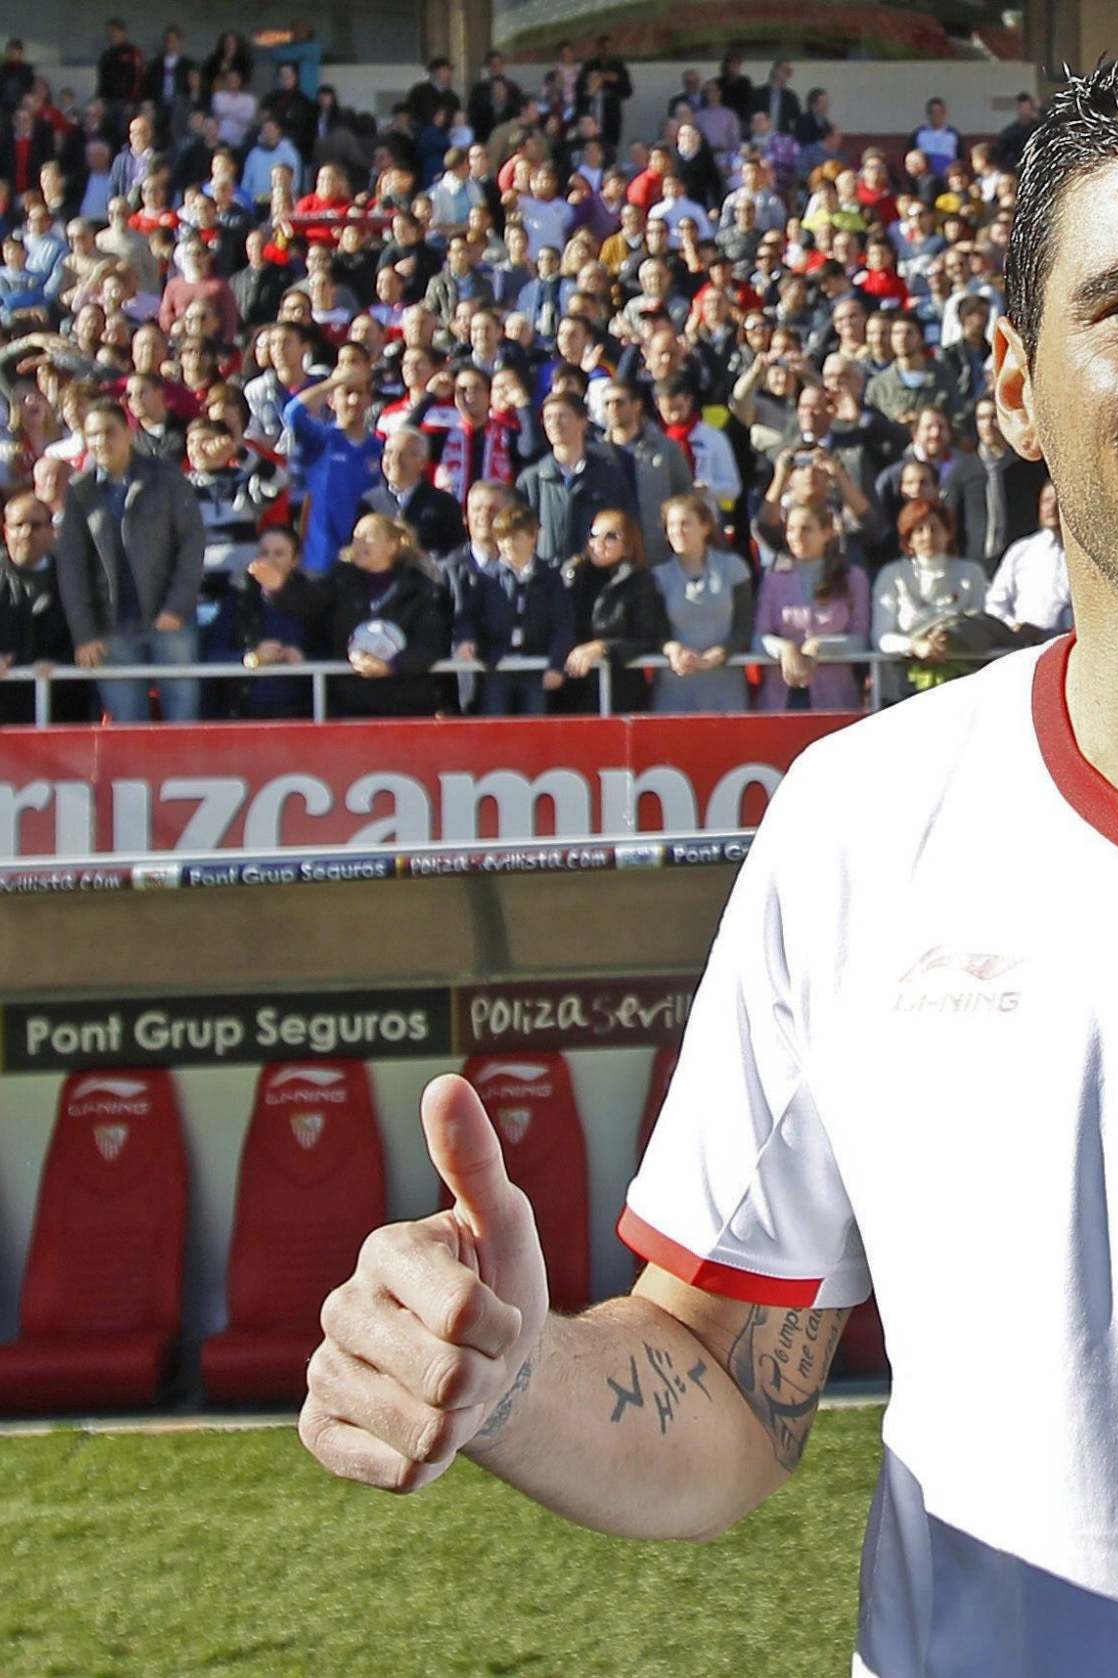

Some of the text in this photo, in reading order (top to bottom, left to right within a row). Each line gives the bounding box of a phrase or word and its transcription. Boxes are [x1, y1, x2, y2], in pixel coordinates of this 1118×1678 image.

[673, 843, 750, 863] Pont Gr
[189, 858, 386, 888] Pont Grup Seguros
[26, 1006, 429, 1056] Pont Grup Seguros
